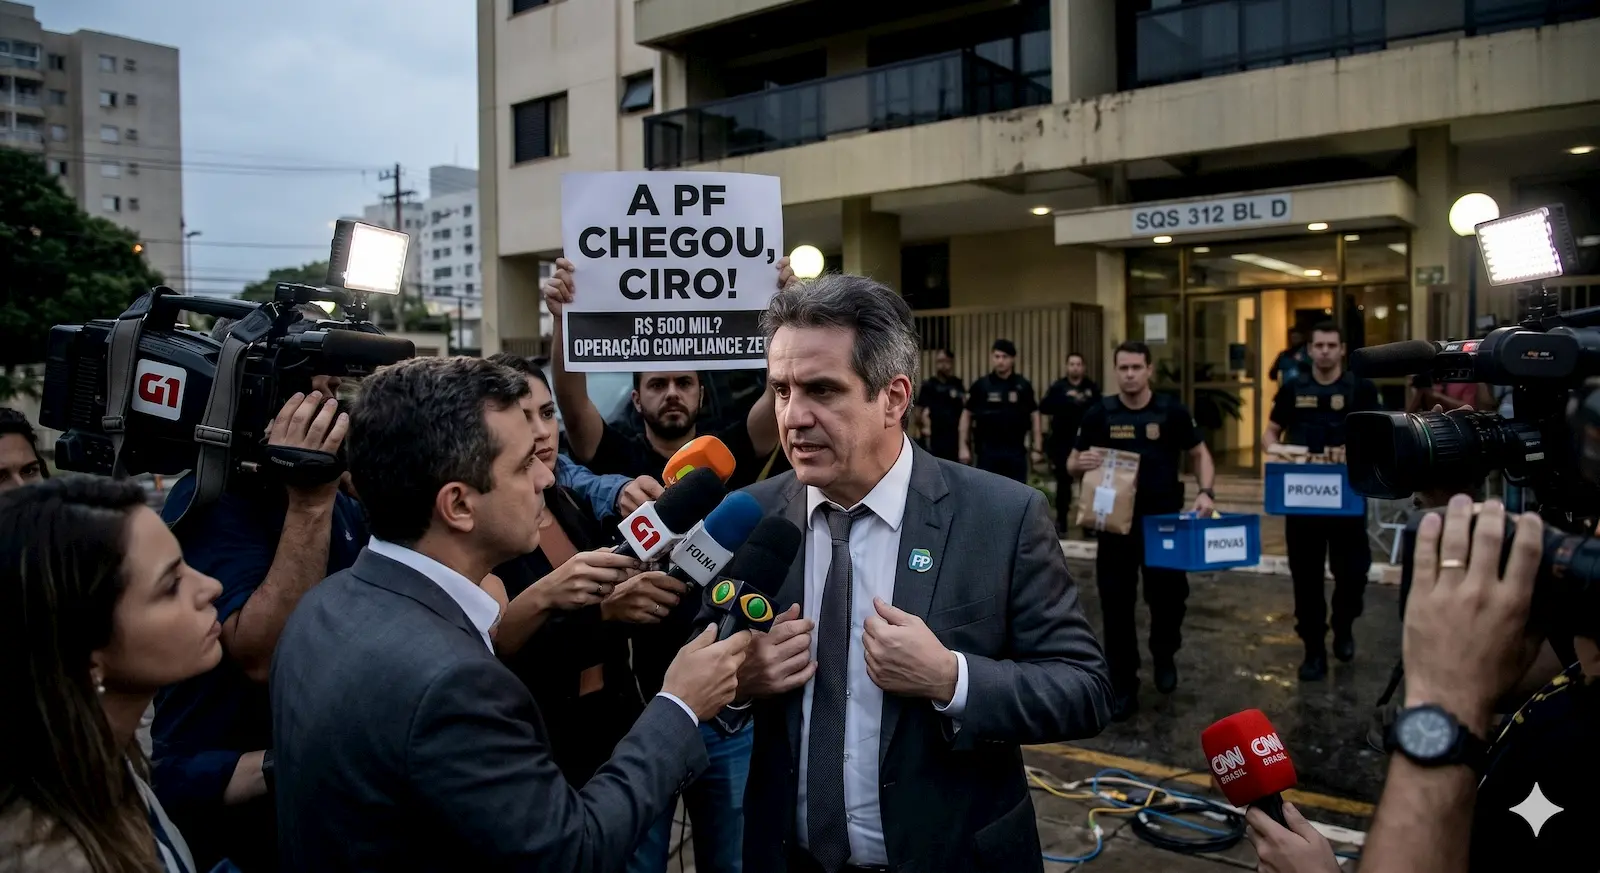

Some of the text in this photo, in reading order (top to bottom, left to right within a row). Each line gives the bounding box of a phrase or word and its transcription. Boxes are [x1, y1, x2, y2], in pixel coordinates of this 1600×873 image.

[627, 184, 726, 216] A PF
[1136, 199, 1287, 230] SQS 312 BL D
[578, 226, 775, 264] CHEGOU,
[618, 267, 737, 300] CIRO!
[634, 316, 722, 335] R$ 500 MIL?
[574, 335, 650, 359] OPERAÇÃO
[653, 336, 743, 356] COMPLIANCE
[138, 372, 181, 409] G1
[1287, 484, 1339, 496] PROVAS
[630, 515, 661, 551] G1
[1207, 537, 1244, 549] PROVAS
[1251, 732, 1284, 756] CNN
[1211, 745, 1246, 775] CNN
[1262, 752, 1287, 766] BRASIL
[1220, 767, 1247, 785] BRASIL
